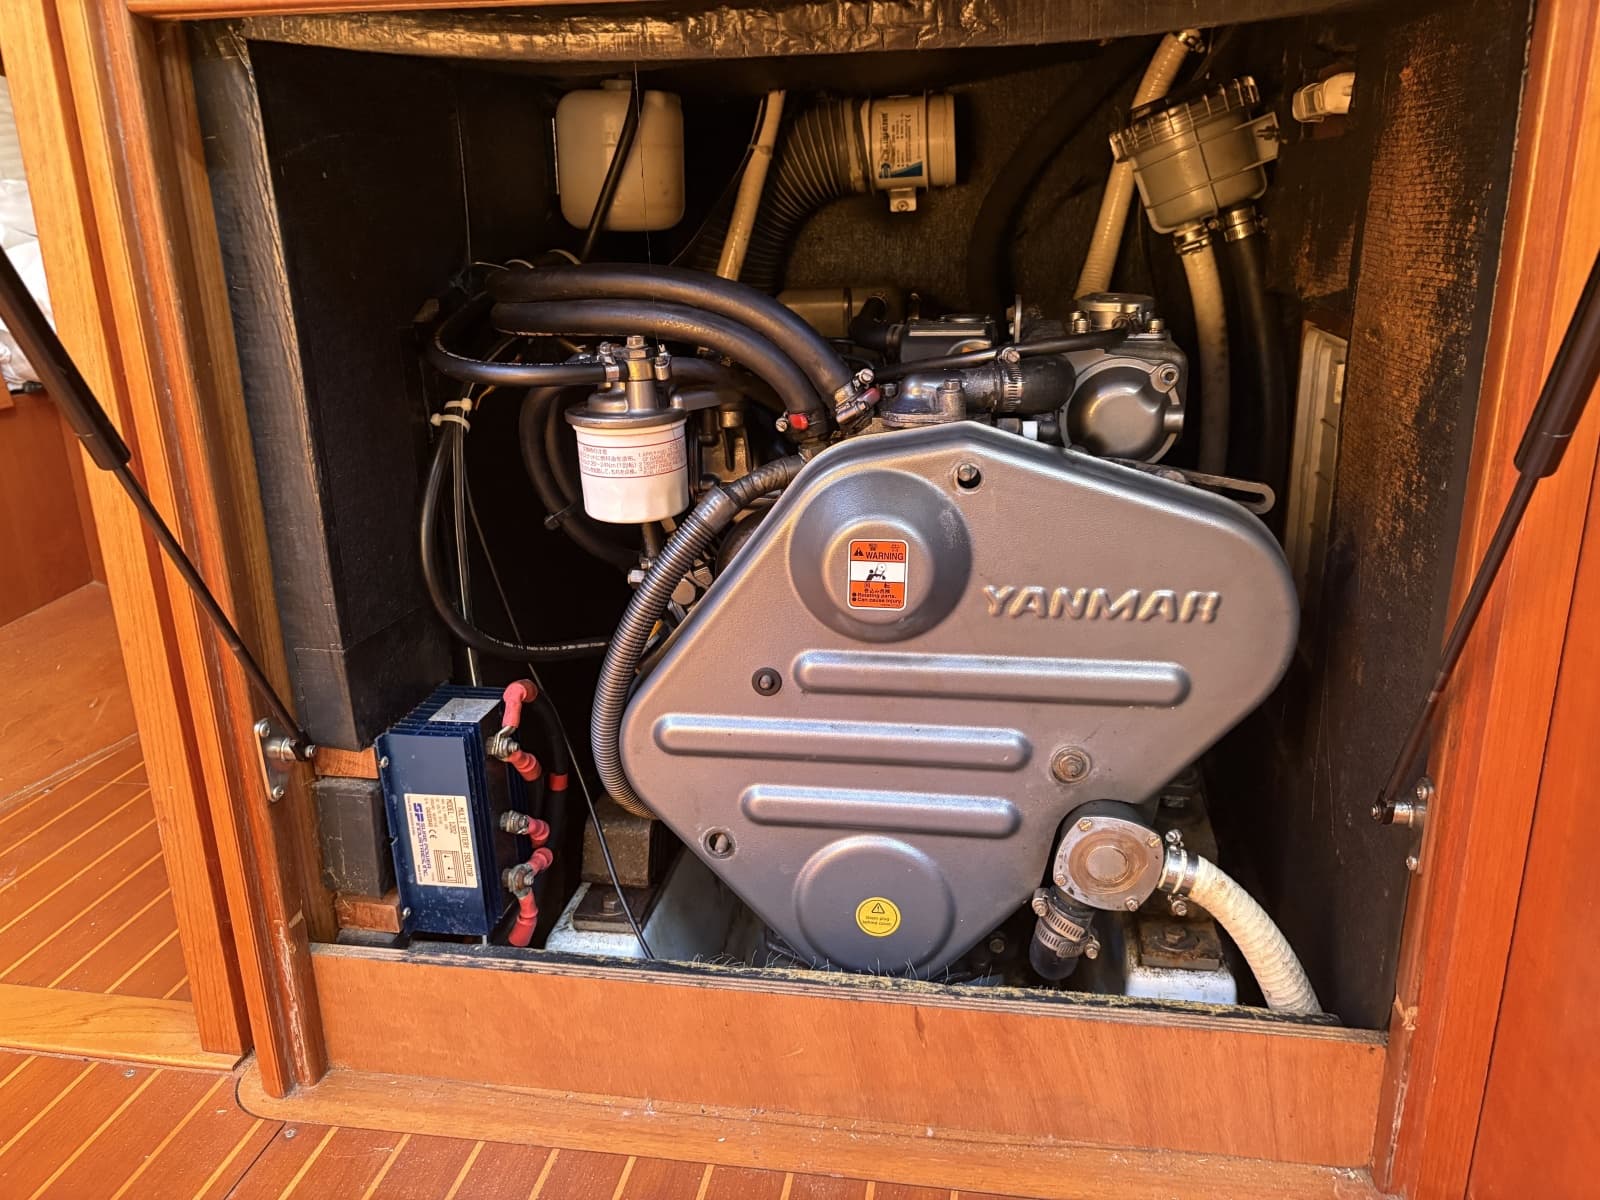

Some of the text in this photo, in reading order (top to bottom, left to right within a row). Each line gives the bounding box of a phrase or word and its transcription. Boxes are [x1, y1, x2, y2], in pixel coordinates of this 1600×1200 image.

[866, 552, 903, 560] WARNING
[983, 584, 1222, 624] YANMAR
[413, 803, 424, 822] SP
[423, 843, 431, 869] POWER
[460, 825, 470, 849] BATTERY
[463, 852, 474, 877] ISOLATOR
